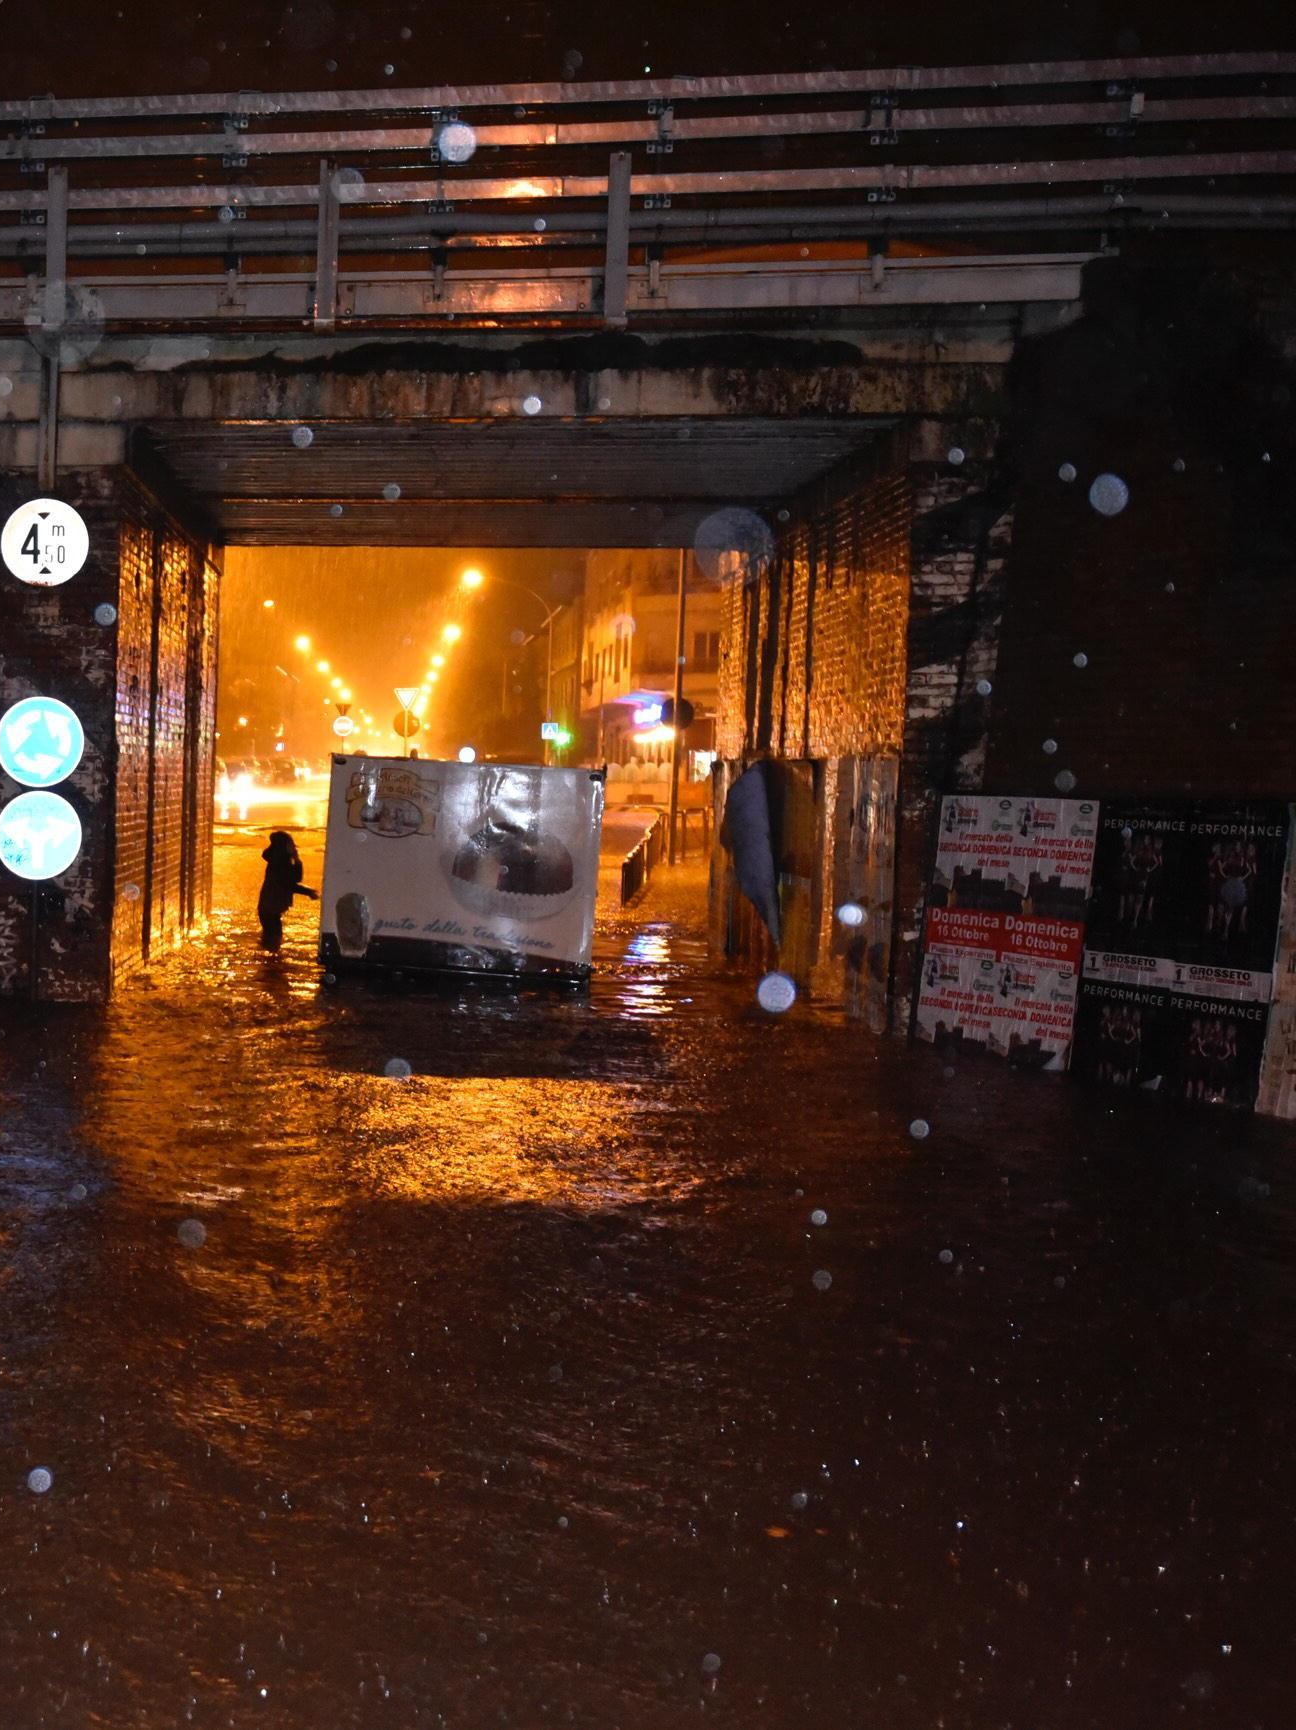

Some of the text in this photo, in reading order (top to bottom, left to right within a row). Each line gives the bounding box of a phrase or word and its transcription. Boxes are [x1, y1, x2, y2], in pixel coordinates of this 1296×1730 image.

[52, 525, 65, 536] m
[20, 523, 41, 564] 4
[1104, 818, 1186, 833] PERFORMANCE
[1190, 823, 1284, 838] PERFORMANCE
[1041, 837, 1073, 849] mercato
[932, 907, 1000, 929] Domenica
[936, 925, 949, 937] 16
[951, 926, 990, 942] Ottobre
[1004, 914, 1079, 940] Domenica
[1010, 933, 1023, 946] 16
[1025, 937, 1068, 953] Ottobre
[1103, 953, 1157, 968] GROSSETO
[1189, 966, 1251, 982] GROSSETO
[1083, 984, 1164, 1007] PERFORMANCE
[1169, 997, 1263, 1022] PERFORMANCE
[1030, 1011, 1072, 1028] DOMENICA
